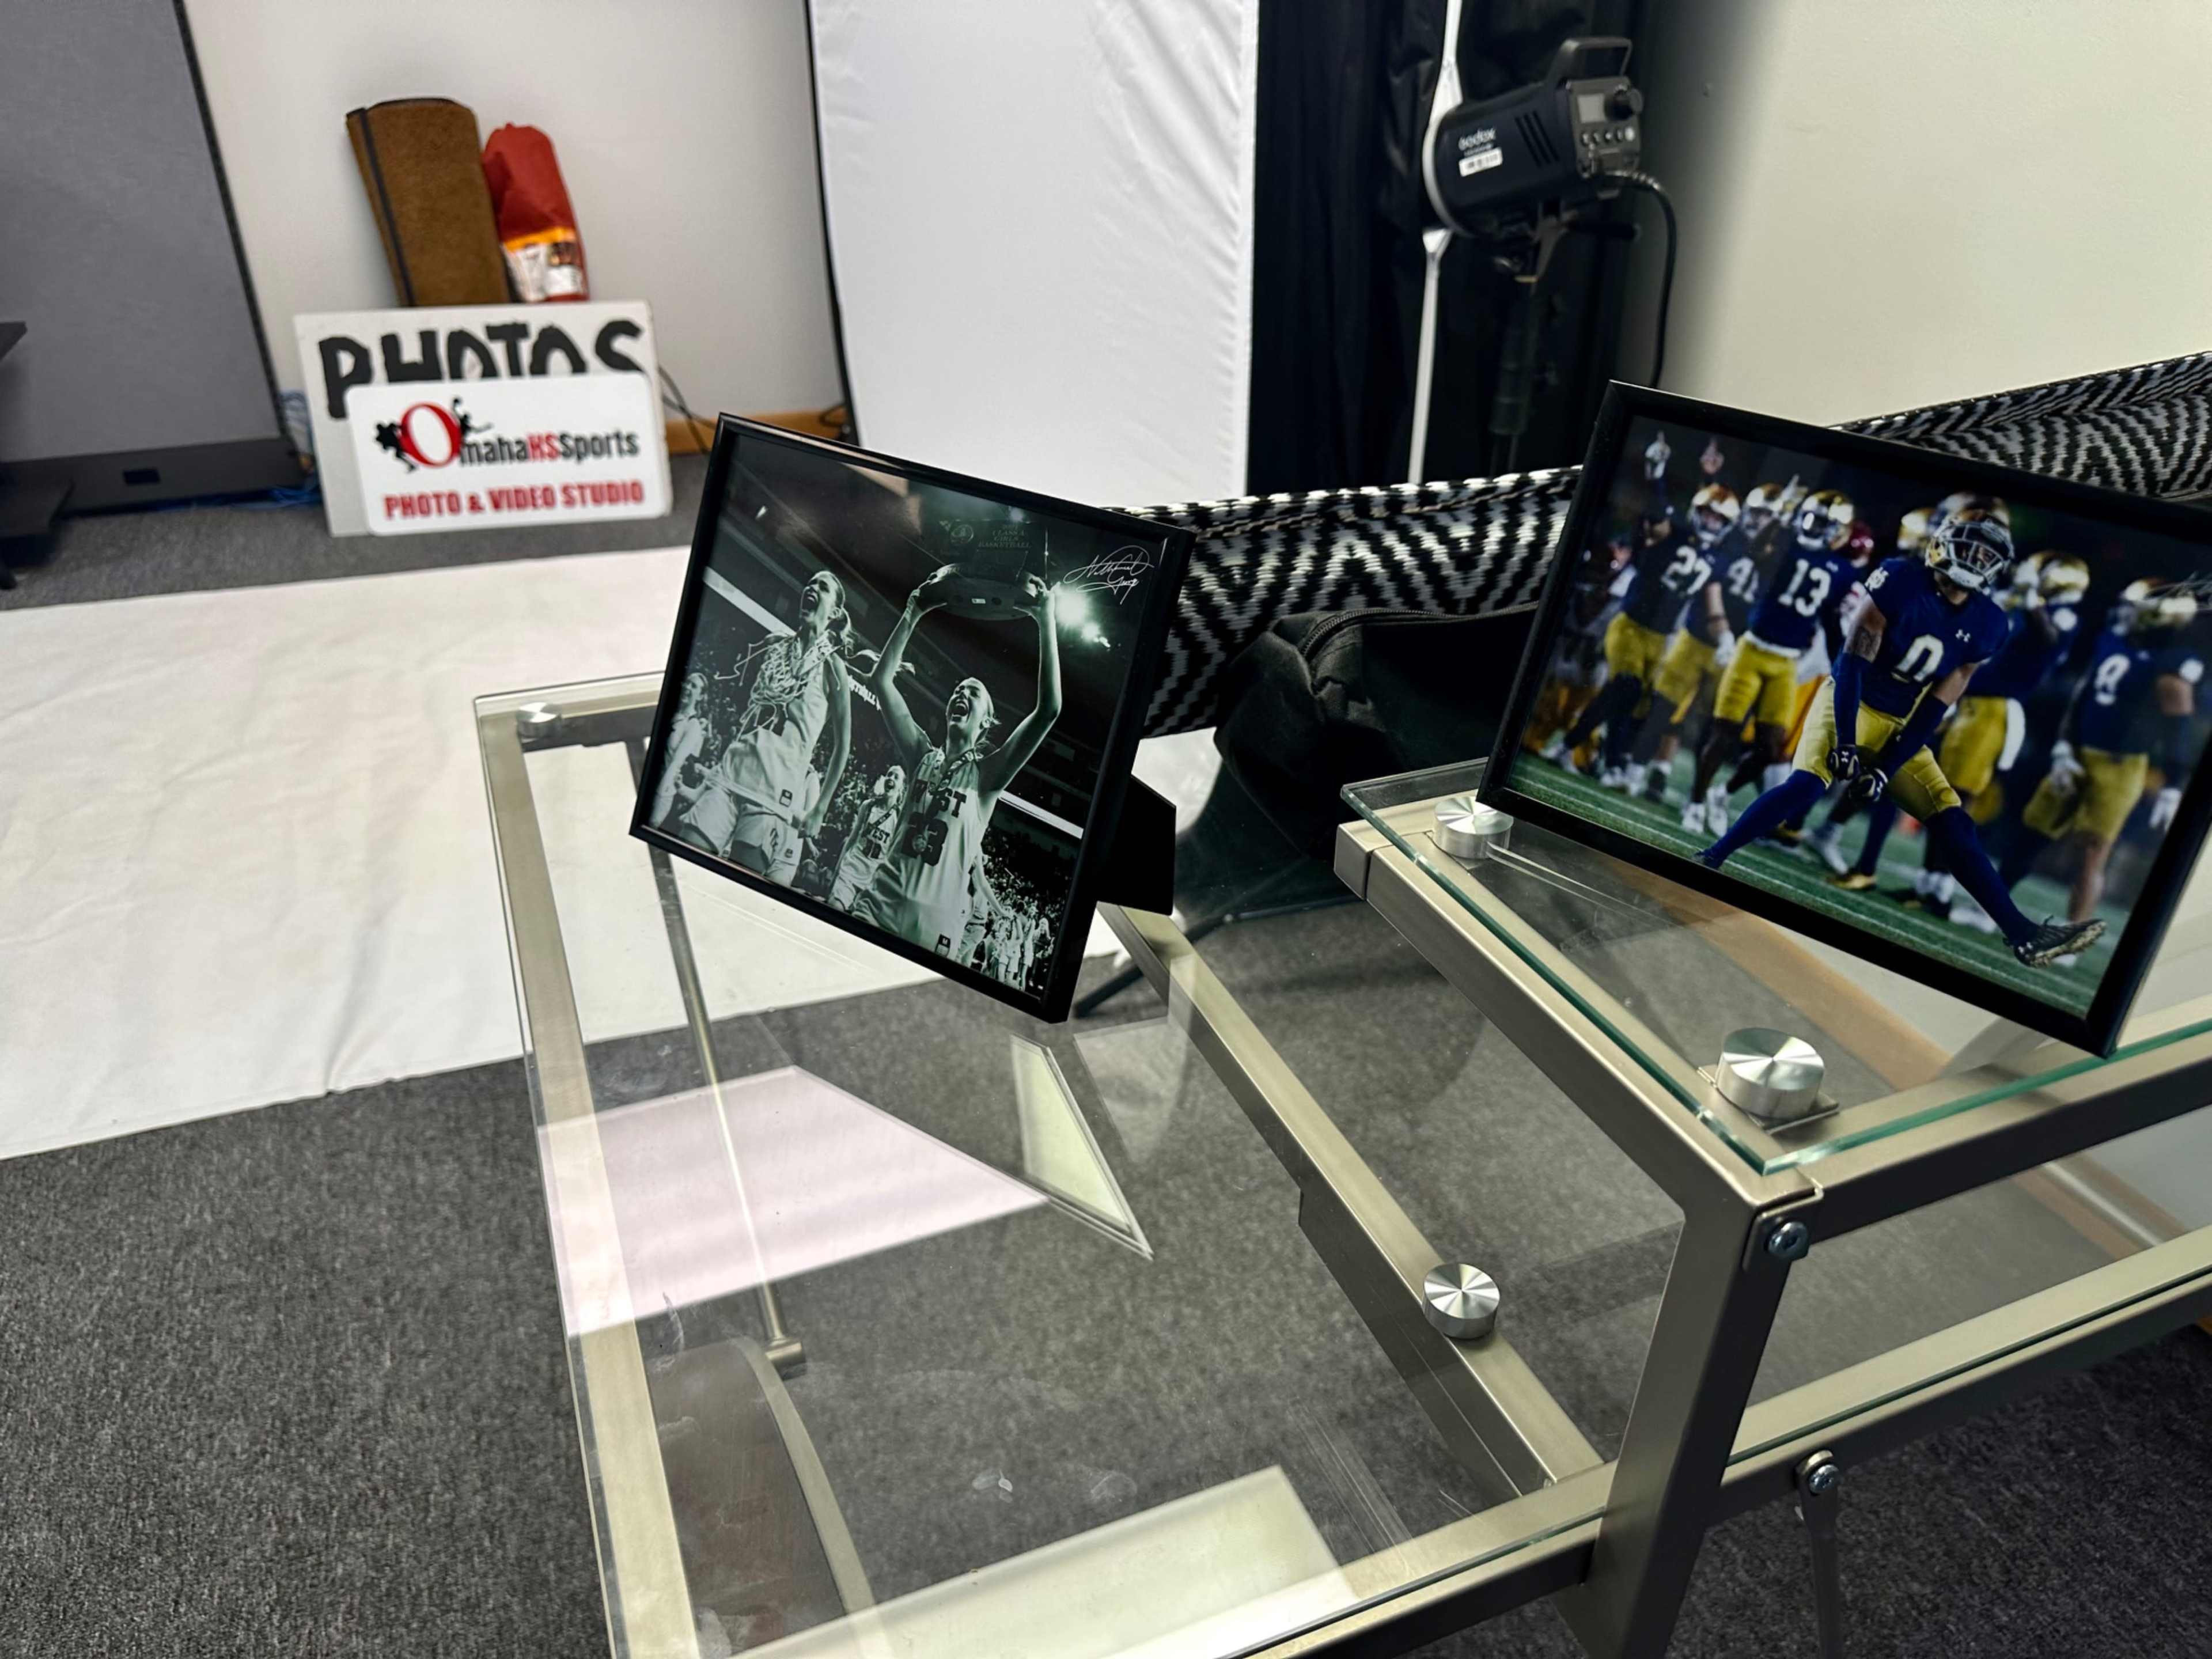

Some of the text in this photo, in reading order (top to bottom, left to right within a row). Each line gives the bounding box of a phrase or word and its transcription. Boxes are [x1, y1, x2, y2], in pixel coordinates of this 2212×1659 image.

[384, 480, 645, 520] PHOTO & VIDEO STUDIO
[1778, 558, 1832, 616] 13
